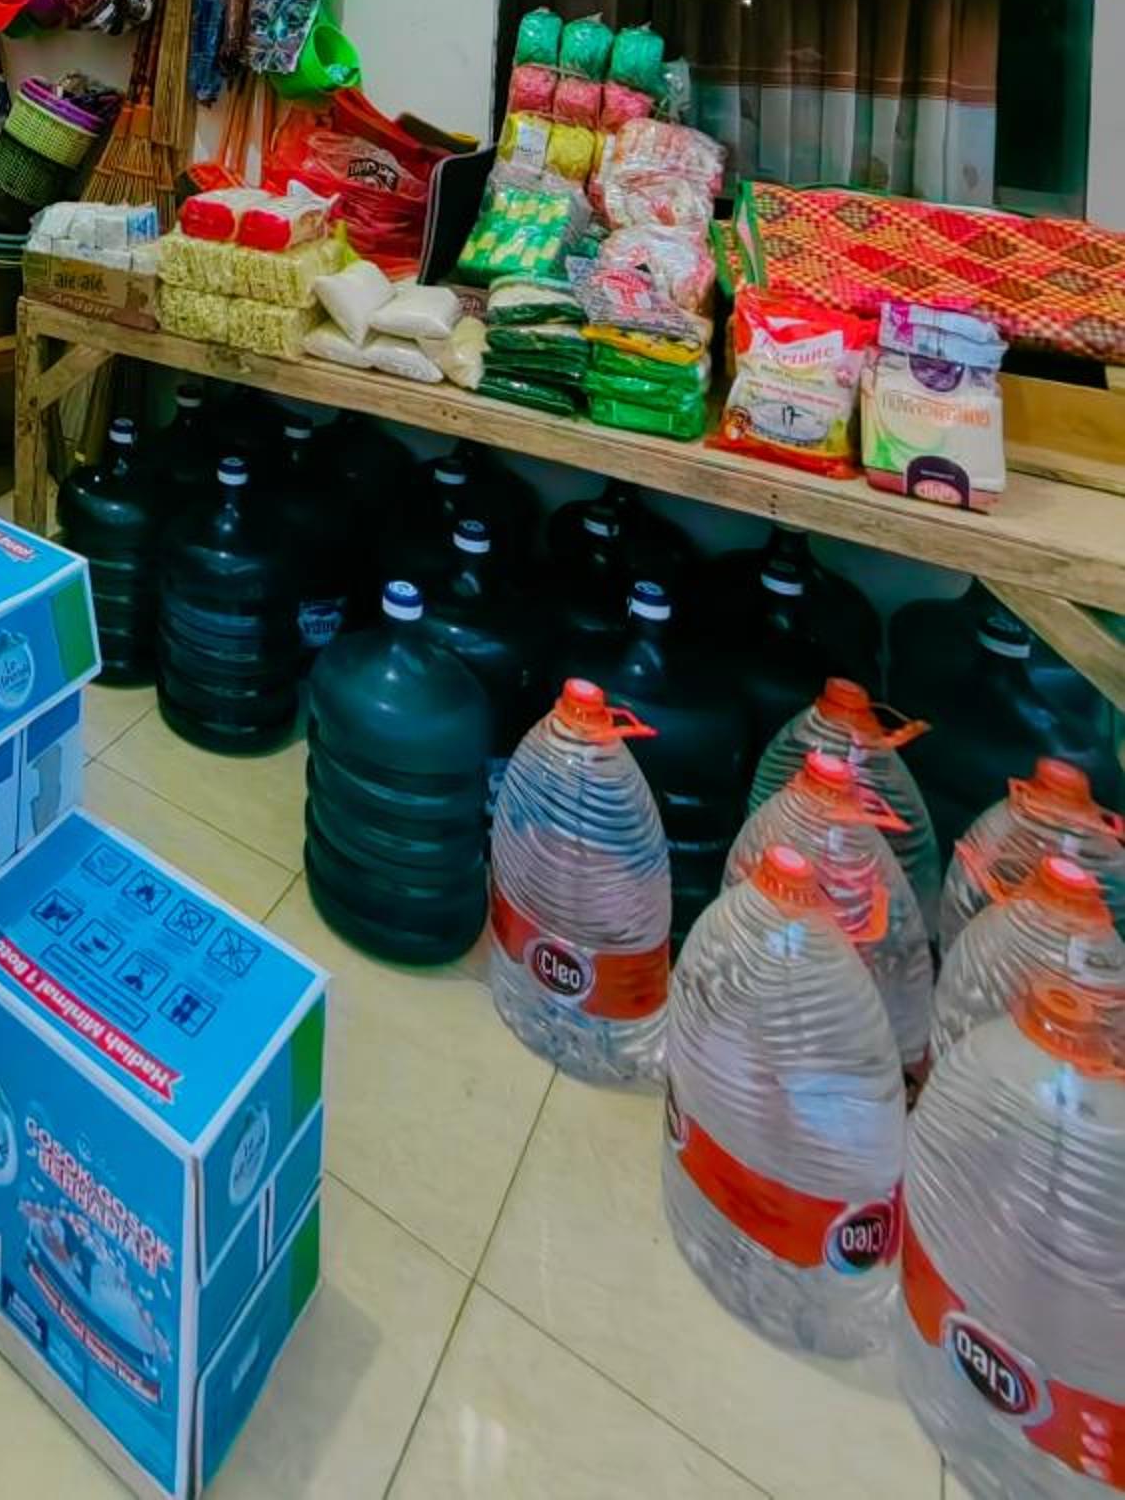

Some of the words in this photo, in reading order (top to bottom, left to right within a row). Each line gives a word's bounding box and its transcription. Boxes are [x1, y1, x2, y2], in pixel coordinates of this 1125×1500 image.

[539, 949, 581, 990] Cleo
[35, 979, 105, 1039] Minimal
[103, 1028, 170, 1090] Hadiah
[26, 1116, 173, 1268] GOSOK-GOSOK
[39, 1148, 158, 1276] BERHADIAH
